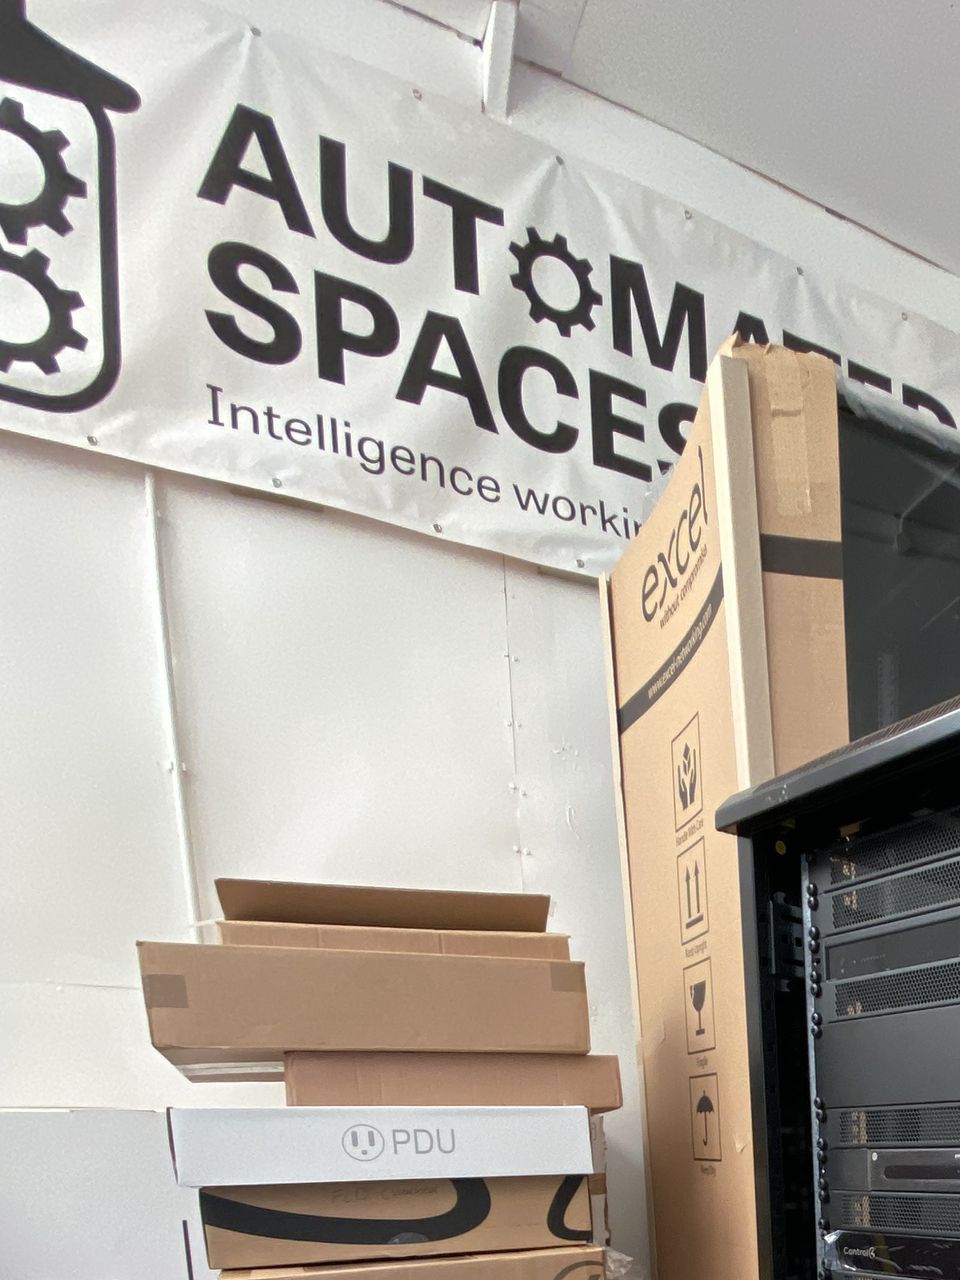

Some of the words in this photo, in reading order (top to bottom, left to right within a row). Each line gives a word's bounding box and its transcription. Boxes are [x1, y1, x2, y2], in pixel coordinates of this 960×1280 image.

[197, 102, 957, 429] AUTOM
[206, 383, 501, 503] Intelligence
[641, 445, 708, 623] excel
[391, 1128, 456, 1155] PDU
